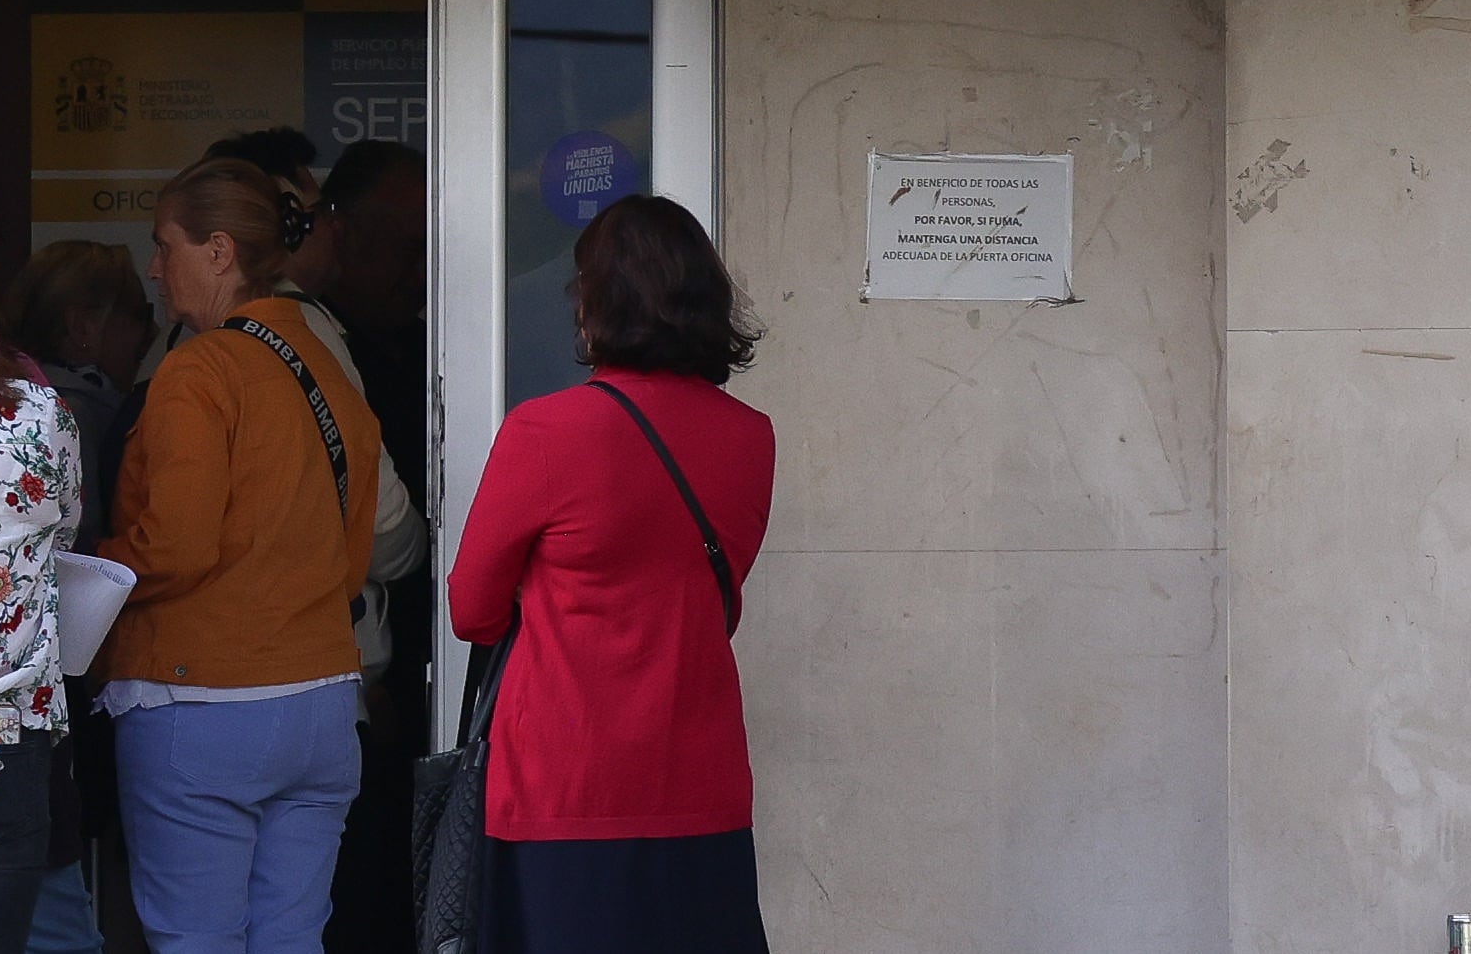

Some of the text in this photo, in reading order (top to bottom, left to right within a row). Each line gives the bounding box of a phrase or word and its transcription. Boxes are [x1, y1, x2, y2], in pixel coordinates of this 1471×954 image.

[566, 154, 614, 170] MACHISTA
[563, 175, 612, 196] UNIDAS
[901, 178, 1039, 188] EN BENEFICIO DE TODAS LAS
[942, 197, 996, 207] PERSONAS,
[914, 216, 935, 225] POR
[938, 216, 975, 226] FAVOR,
[977, 216, 986, 225] SI
[898, 234, 1038, 245] MANTENGA UNA DISTANCIA
[882, 251, 1053, 262] ADECUADA DE LA PUERTA OFICINA
[242, 319, 303, 377] BIMBA
[308, 386, 342, 462] BIMBA
